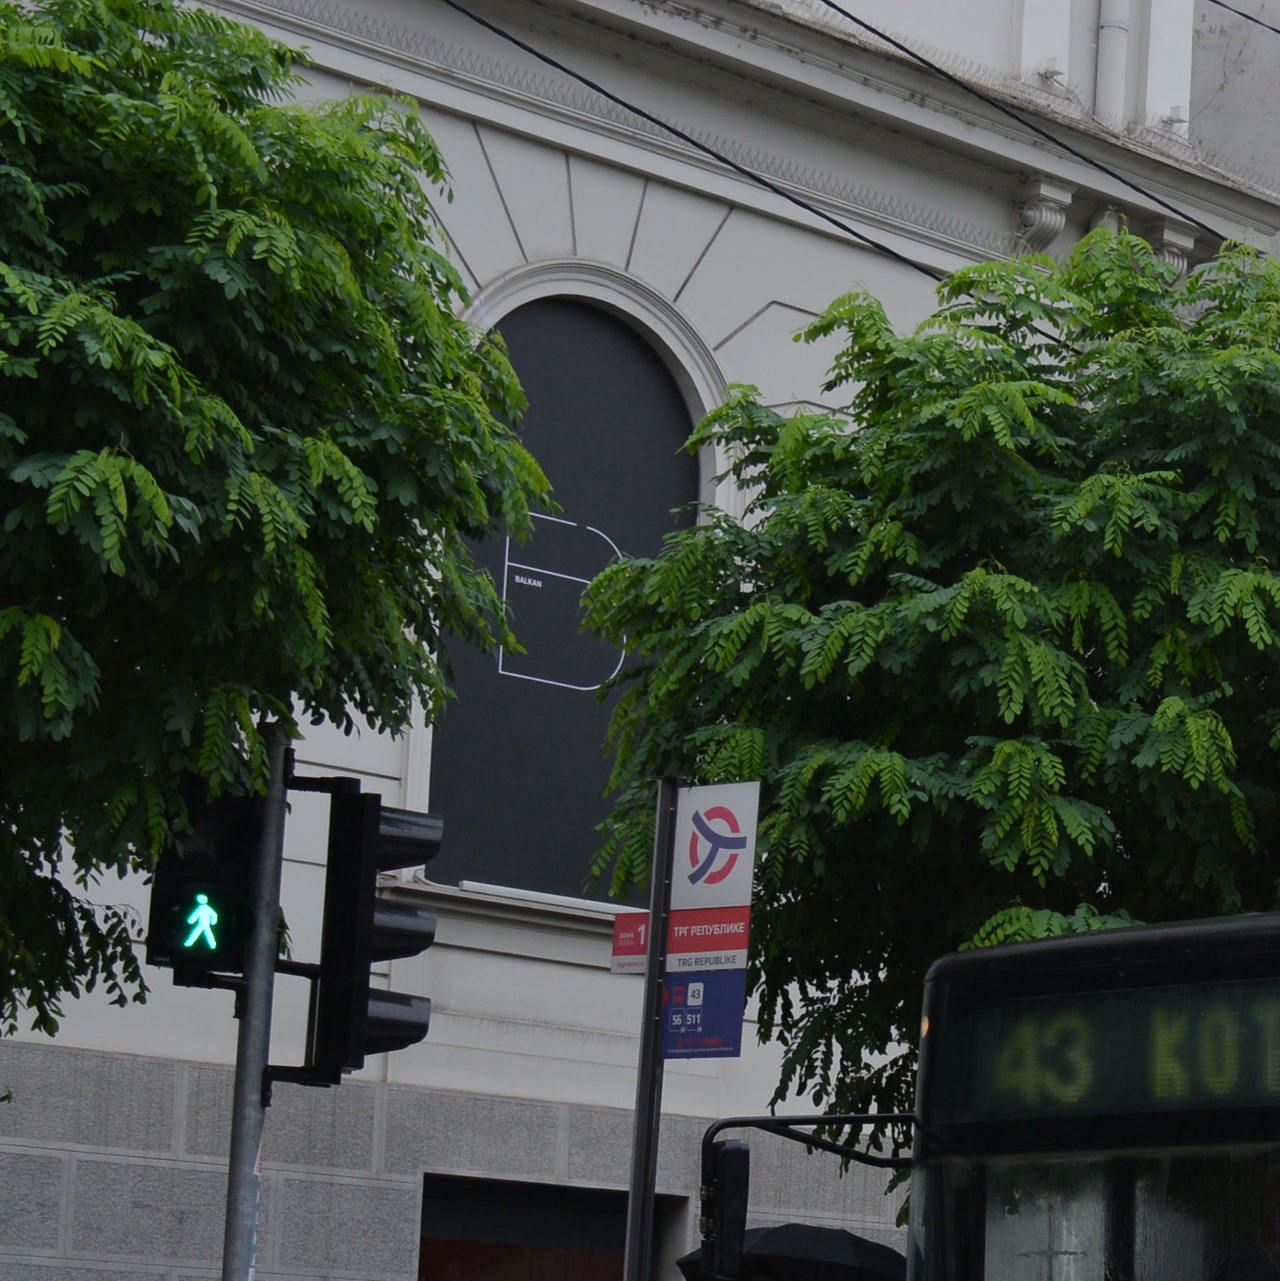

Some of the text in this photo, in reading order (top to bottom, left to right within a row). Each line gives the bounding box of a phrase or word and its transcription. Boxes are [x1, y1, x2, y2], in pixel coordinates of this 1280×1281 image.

[514, 575, 543, 588] BALKAN
[637, 923, 646, 946] 1
[673, 922, 745, 937] ТРГ РЕПУБЛИКЕ
[677, 954, 737, 968] TRG REPUBLIKE
[691, 989, 700, 999] 43
[673, 1013, 701, 1025] 56 511
[995, 1010, 1095, 1105] 43
